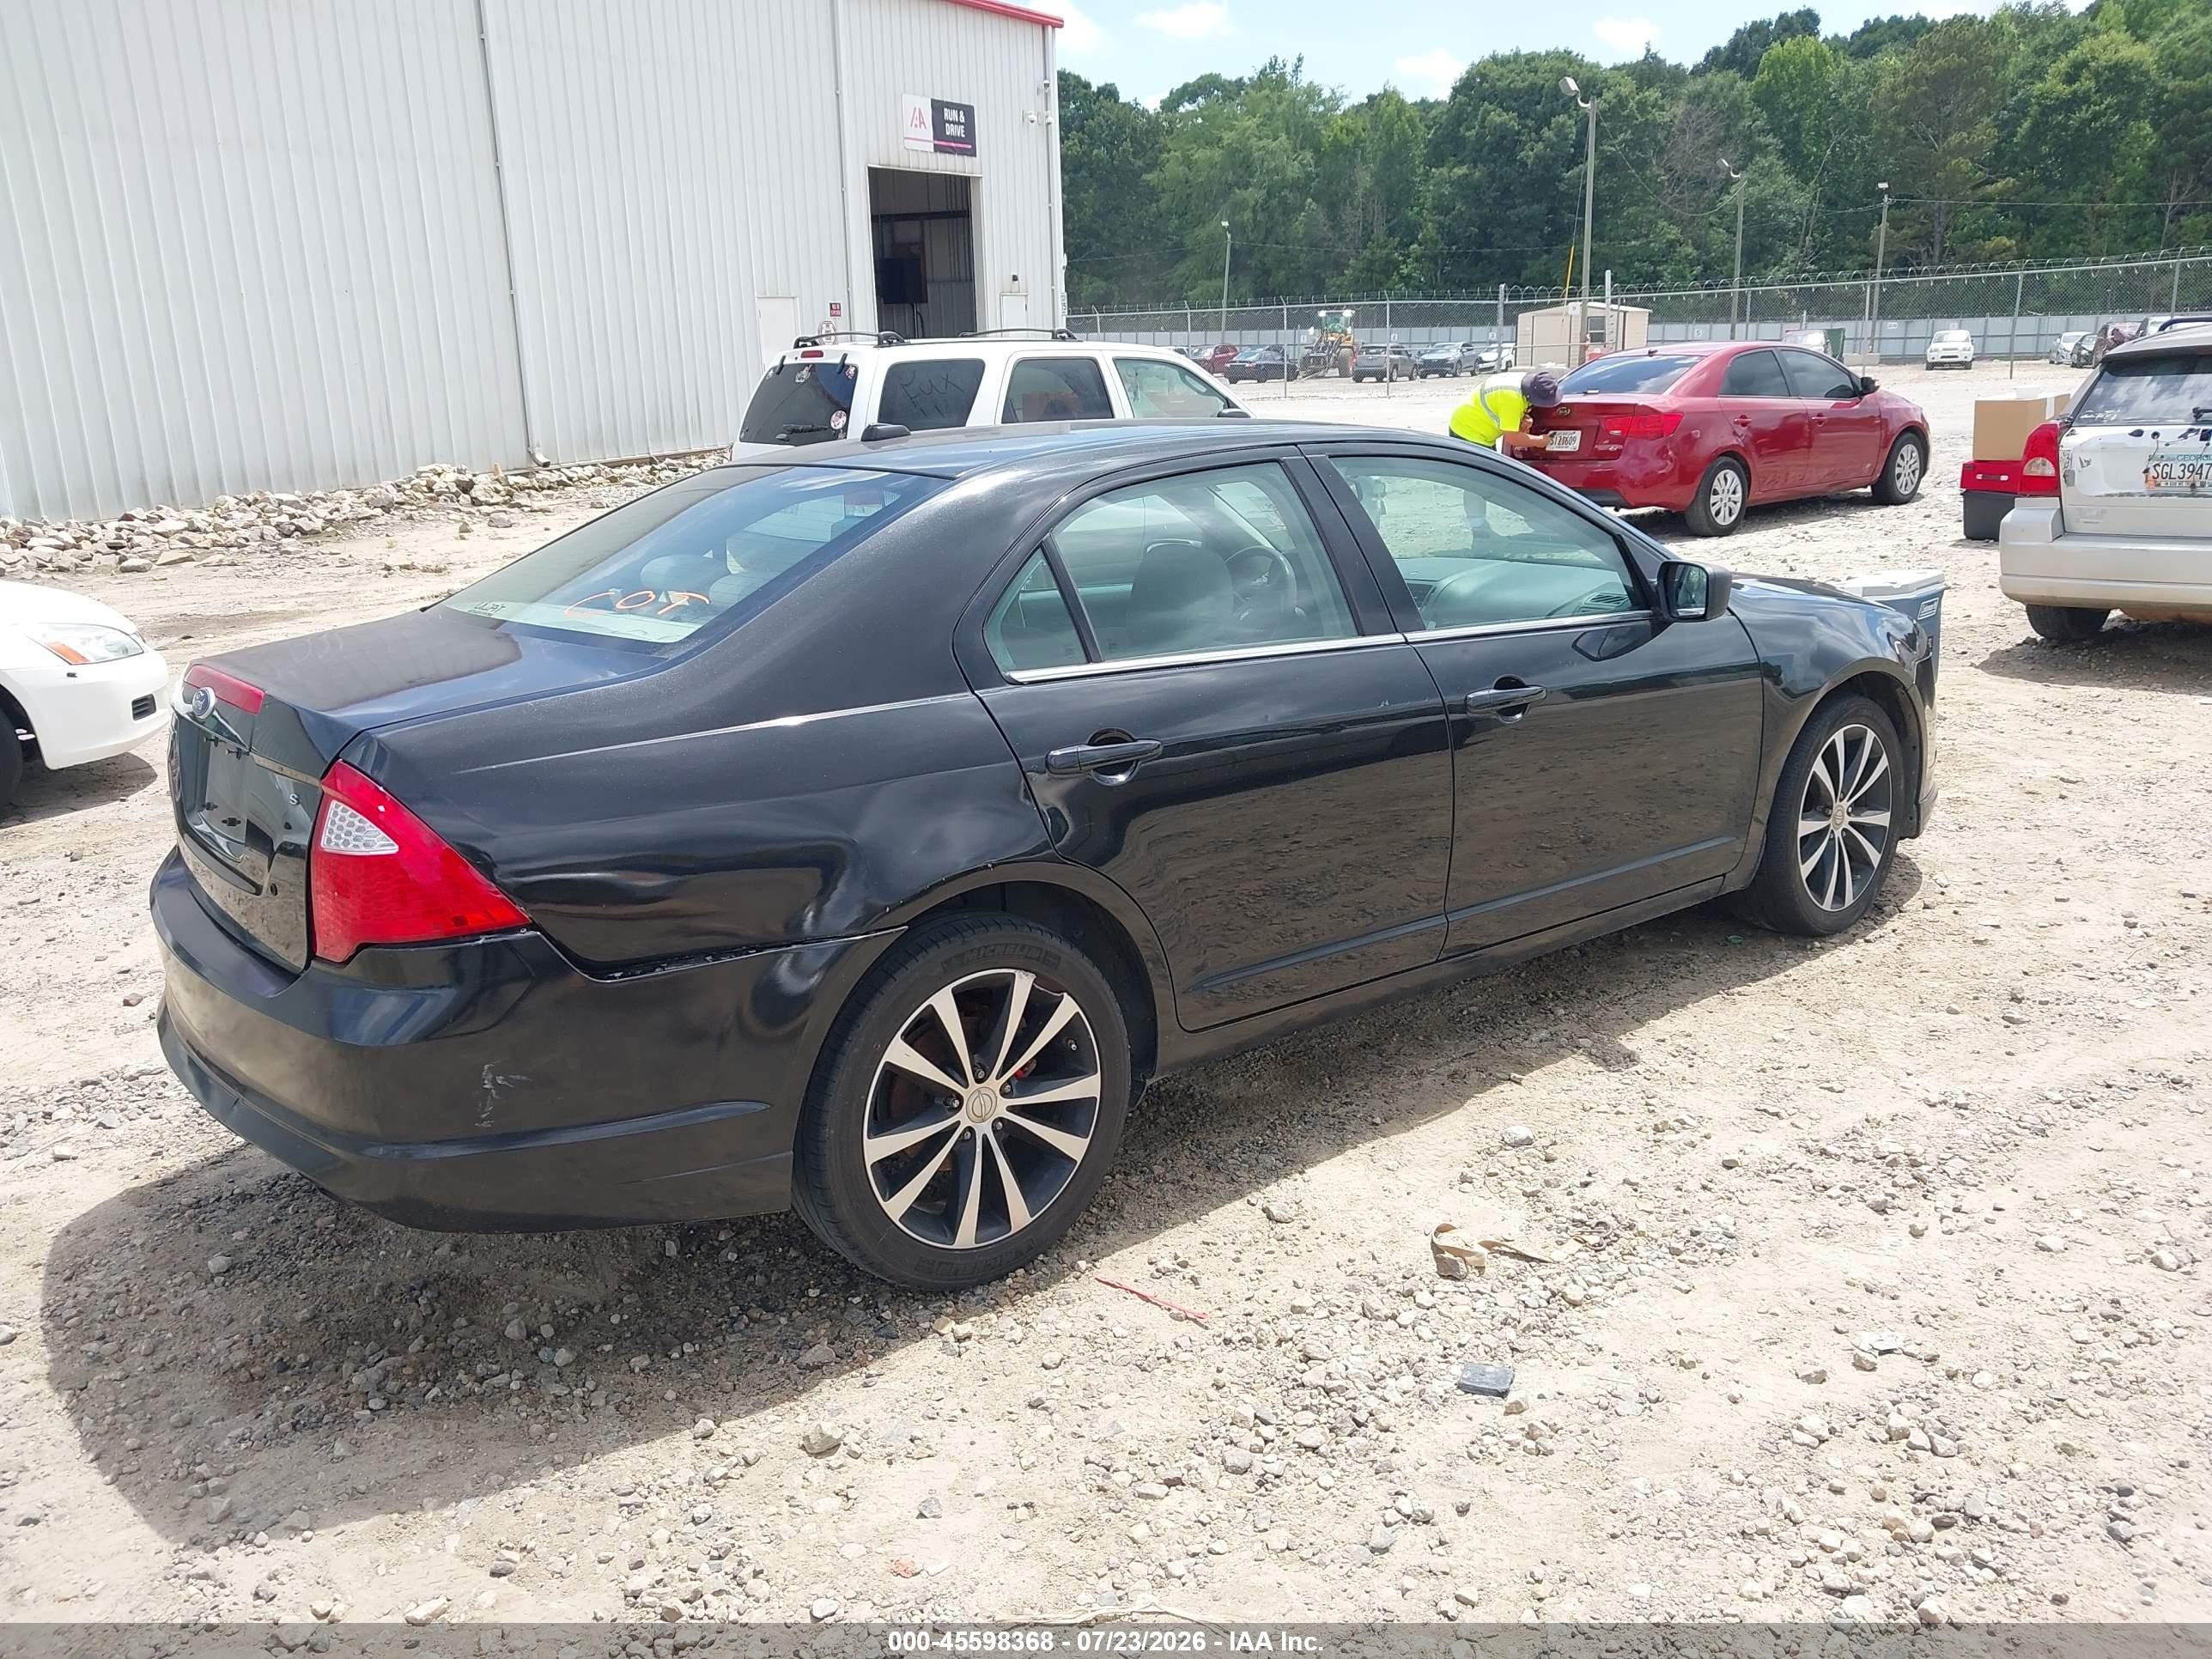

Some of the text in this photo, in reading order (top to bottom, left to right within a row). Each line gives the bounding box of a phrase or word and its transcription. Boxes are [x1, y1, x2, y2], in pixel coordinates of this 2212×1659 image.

[944, 107, 965, 124] RUN &
[945, 123, 965, 137] DRIVE
[2153, 463, 2212, 480] SGL3947
[289, 793, 298, 805] S
